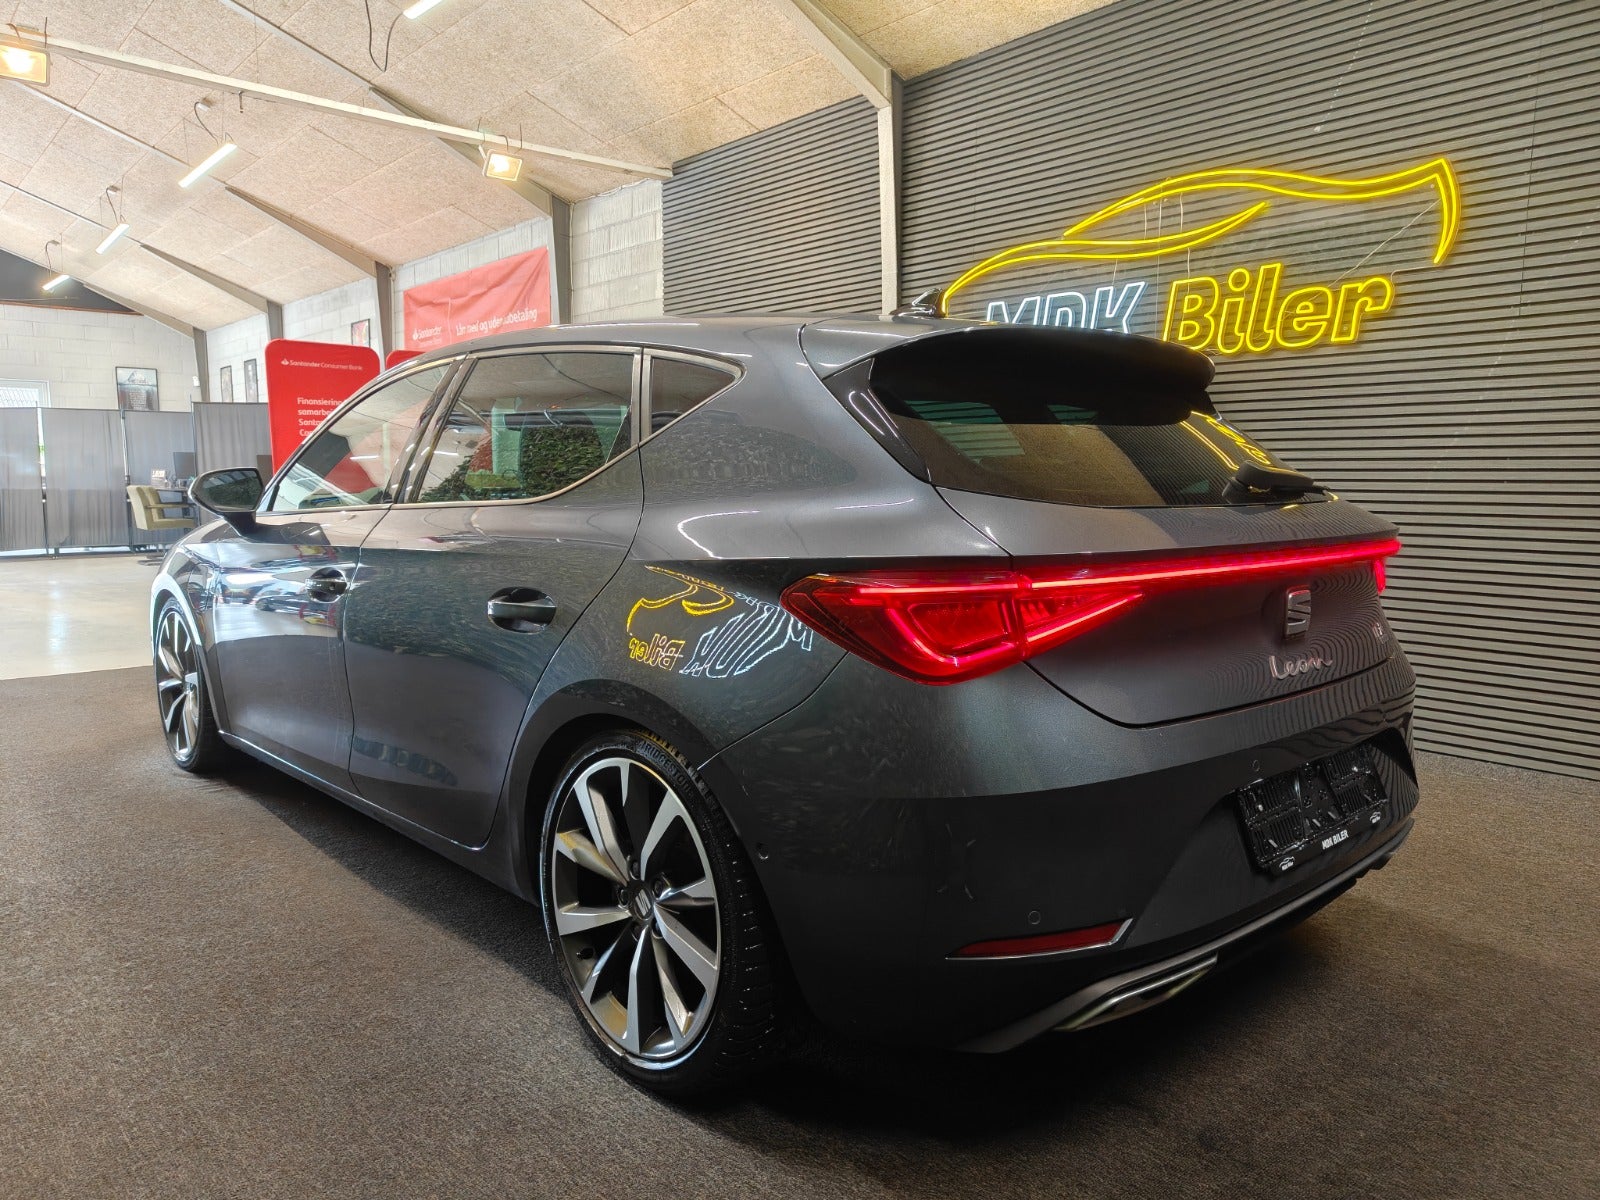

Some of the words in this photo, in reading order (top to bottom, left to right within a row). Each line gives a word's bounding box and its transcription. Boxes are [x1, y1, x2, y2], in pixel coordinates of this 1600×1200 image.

[1162, 262, 1396, 356] Biler
[480, 321, 488, 333] og
[1268, 655, 1333, 680] Leon
[1332, 829, 1349, 844] BILER
